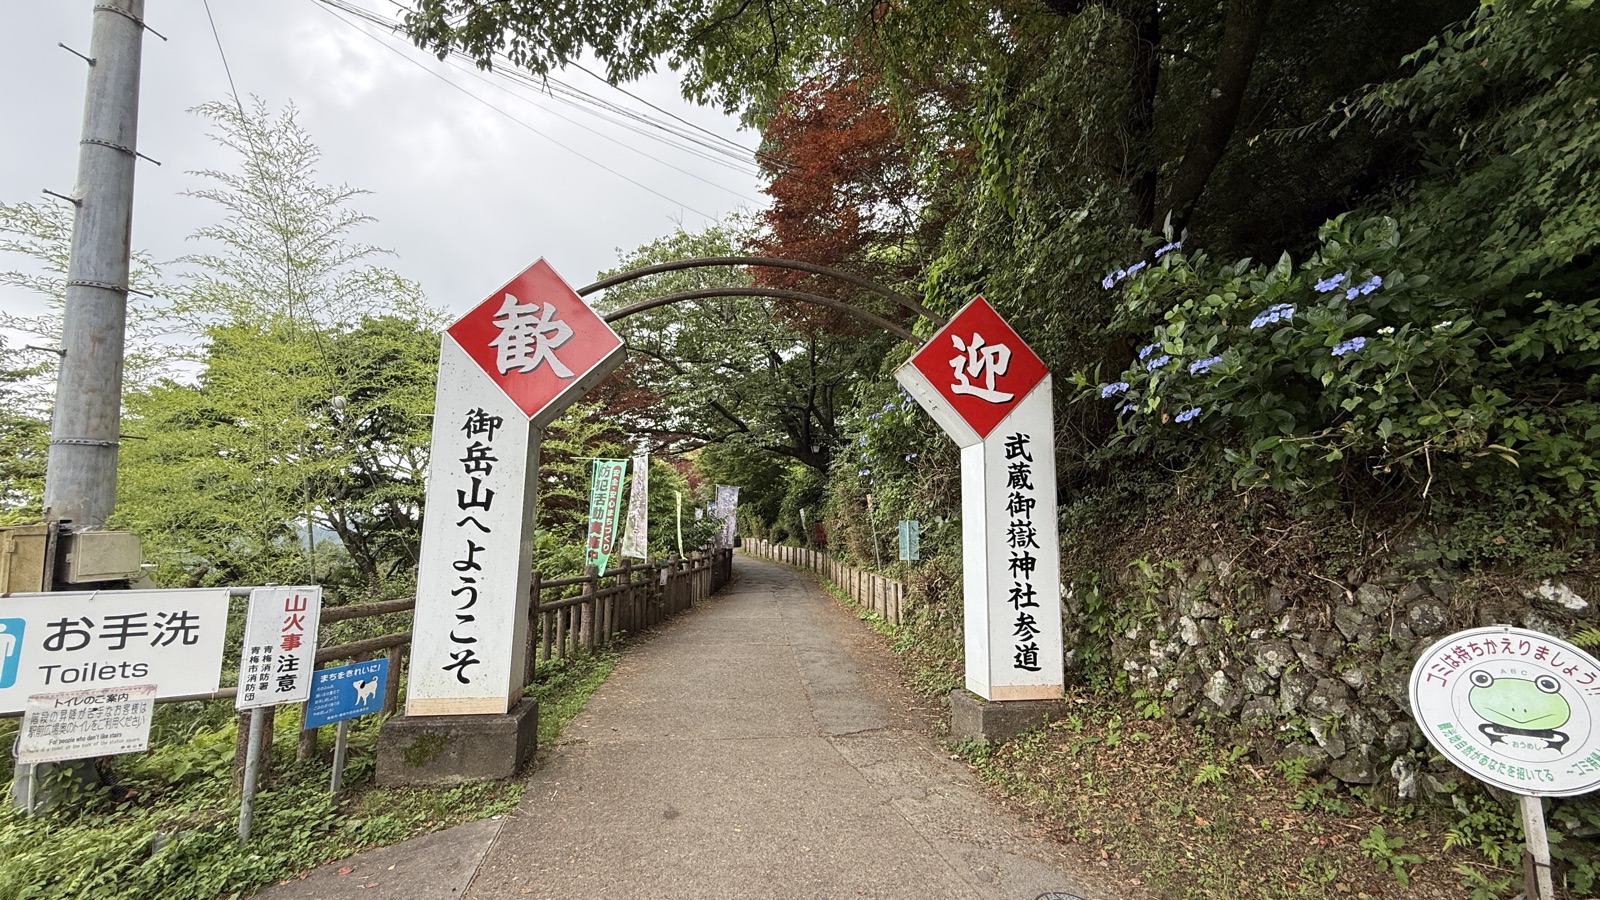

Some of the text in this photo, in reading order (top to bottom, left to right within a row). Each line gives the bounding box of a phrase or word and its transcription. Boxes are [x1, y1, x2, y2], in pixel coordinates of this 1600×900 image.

[488, 293, 576, 379] 歓
[948, 332, 1015, 405] 迎
[441, 407, 504, 685] 御岳山へようこそ
[1004, 432, 1042, 673] 武蔵御嶽神社参道
[42, 610, 200, 652] お手洗
[274, 594, 308, 693] 山火事注意
[38, 661, 149, 685] Toilets
[54, 692, 129, 708] トイレのご案内
[244, 646, 261, 701] 青梅市消防団
[258, 645, 273, 691] 青梅消防署
